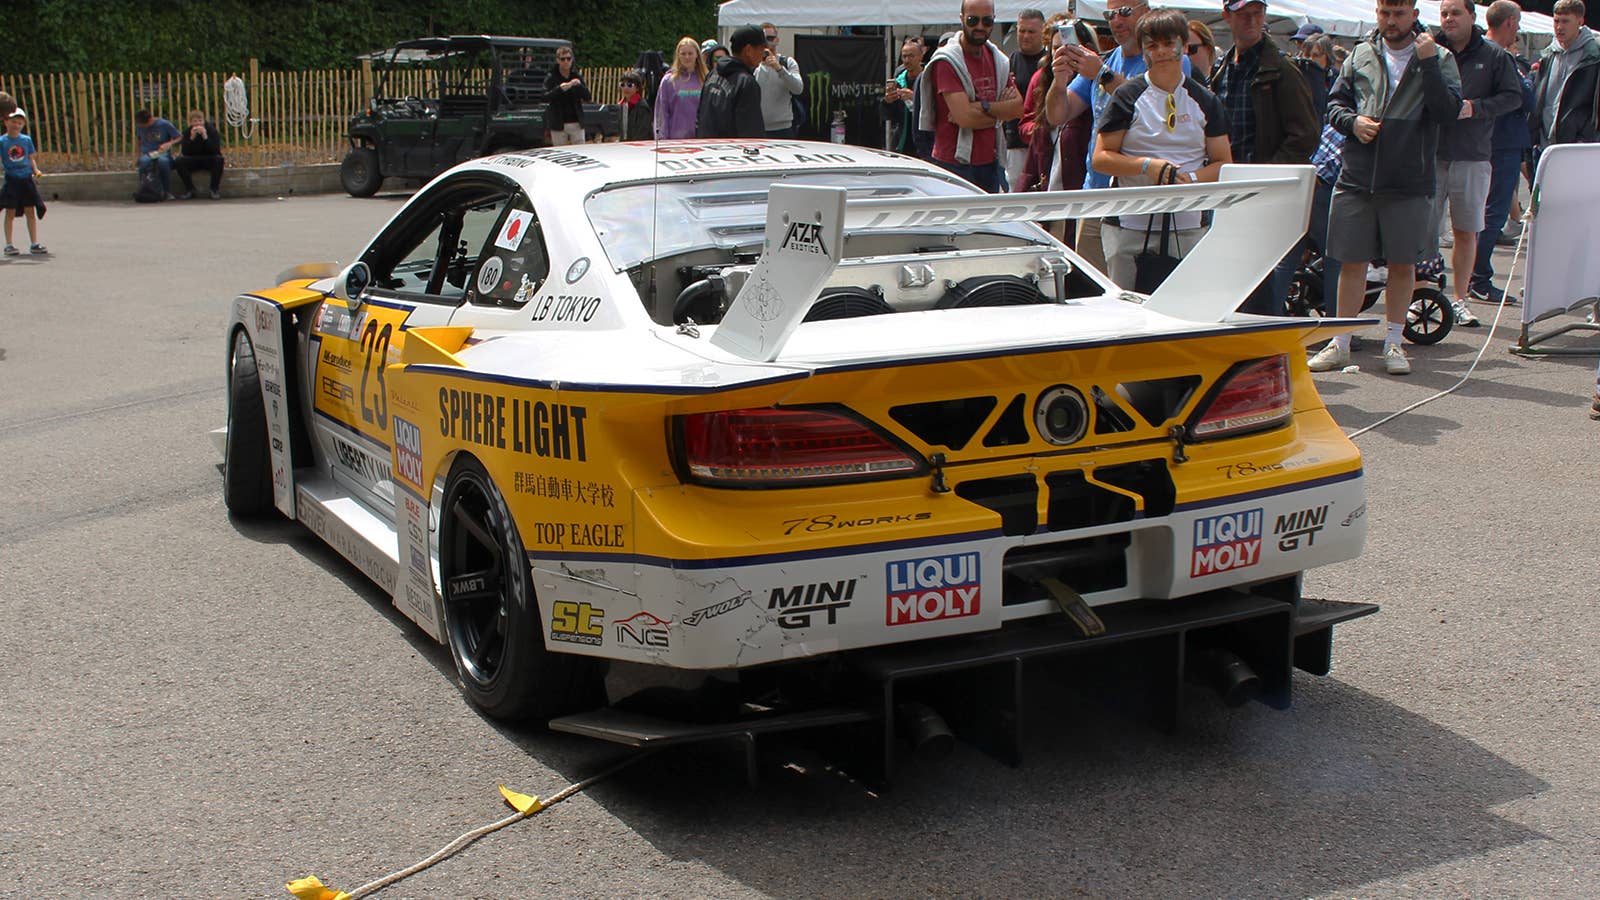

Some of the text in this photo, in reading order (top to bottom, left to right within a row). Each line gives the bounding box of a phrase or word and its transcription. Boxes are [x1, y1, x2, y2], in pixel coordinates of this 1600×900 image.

[831, 81, 883, 98] MONSTE
[791, 242, 819, 254] EXOTICS
[482, 266, 498, 286] 180
[532, 295, 601, 322] LB TOKYO
[360, 318, 392, 430] 23
[395, 417, 420, 456] LIQUI
[439, 386, 586, 463] SPHERE LIGHT
[332, 436, 378, 482] LIBERTY
[397, 448, 422, 486] MOLY
[514, 471, 615, 508] 群馬自動車大学校
[535, 522, 625, 548] TOP EAGLE
[1195, 510, 1260, 547] LIQUI
[1274, 504, 1329, 535] MINI
[1278, 526, 1323, 552] GT
[890, 554, 978, 592] LIQUI
[1193, 539, 1262, 576] MOLY
[452, 578, 486, 594] LBWK
[767, 578, 858, 610] MINI
[777, 601, 851, 630] GT
[890, 586, 979, 625] MOLY
